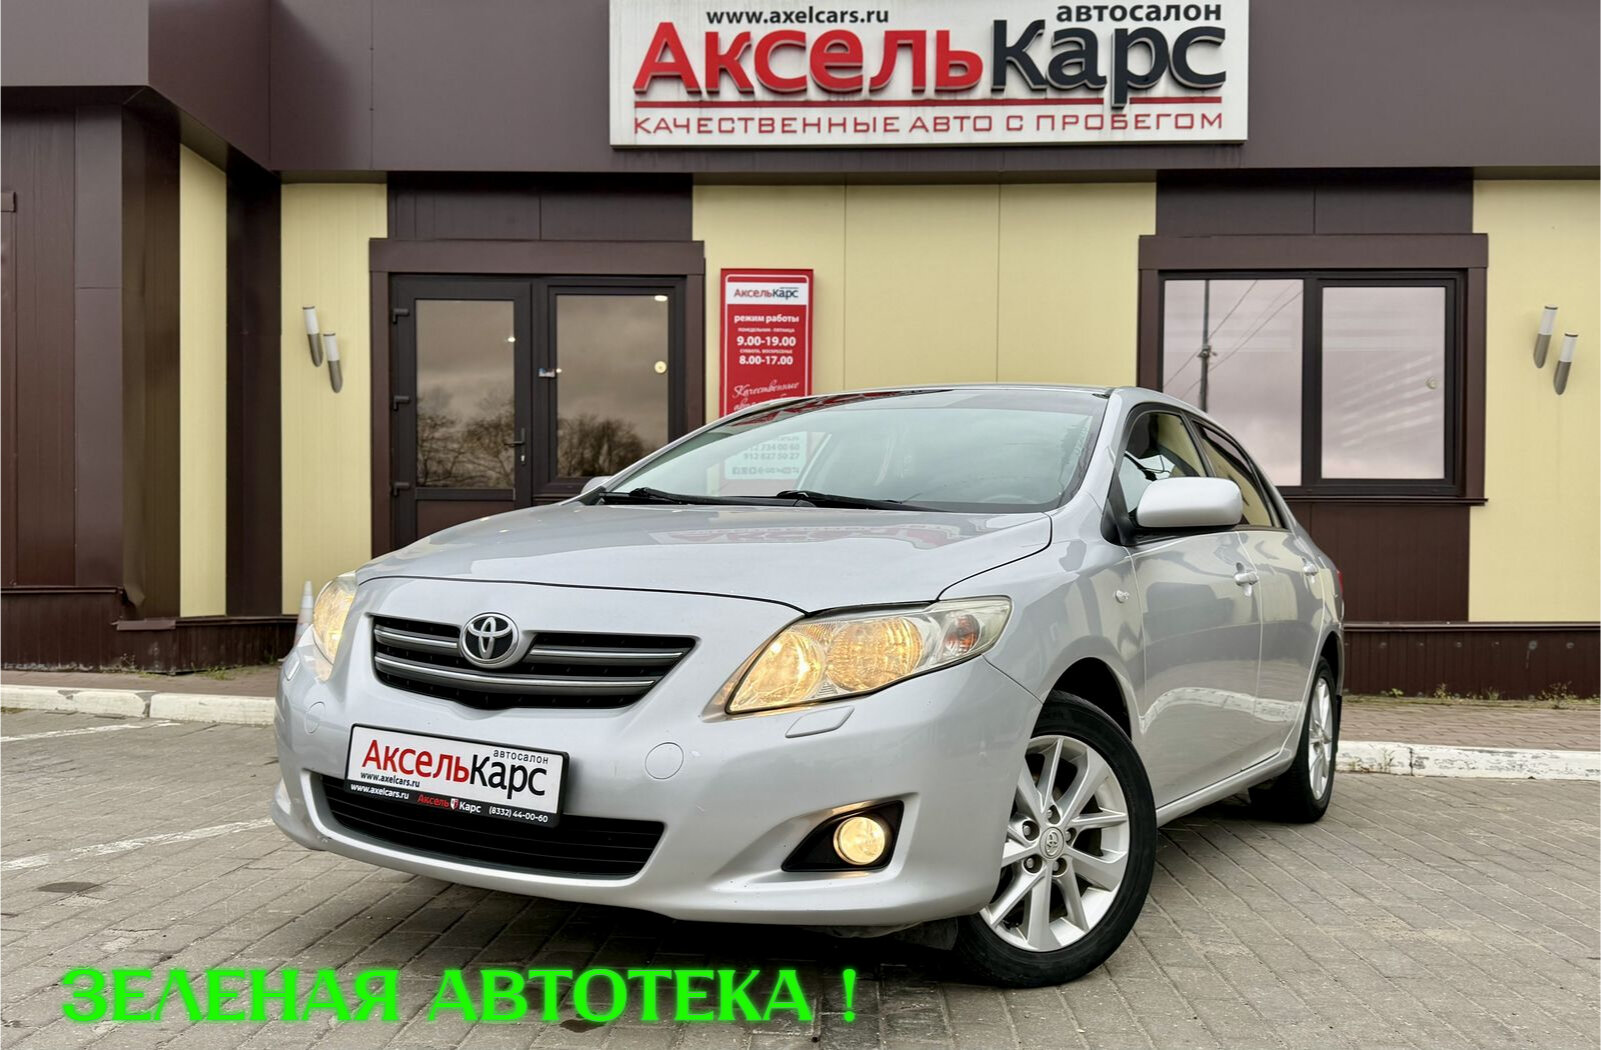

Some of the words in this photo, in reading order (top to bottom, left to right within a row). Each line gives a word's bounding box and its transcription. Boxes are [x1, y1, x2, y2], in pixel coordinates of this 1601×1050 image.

[706, 6, 889, 24] www.axelcars.ru
[1056, 4, 1222, 22] автосалон
[633, 19, 1227, 109] АксельКарс
[634, 116, 900, 134] КАЧЕСТВЕННЫЕ
[909, 115, 993, 133] АВТО
[1006, 115, 1023, 132] С
[1037, 113, 1223, 131] ПРОБЕГОМ
[734, 288, 799, 300] АксельКарс
[734, 315, 765, 324] режим
[766, 313, 799, 324] работы
[736, 335, 797, 347] 9.00-19.00
[739, 355, 794, 365] 8.00-17.00
[493, 749, 549, 765] автосалон
[362, 739, 547, 799] АксельКарс
[360, 771, 420, 788] www.axelcars.ru
[350, 783, 410, 801] www.axelcars.ru
[416, 794, 449, 809] Аксель
[459, 801, 482, 813] Карс
[489, 805, 511, 818] (8332)
[513, 810, 549, 823] 44-00-60
